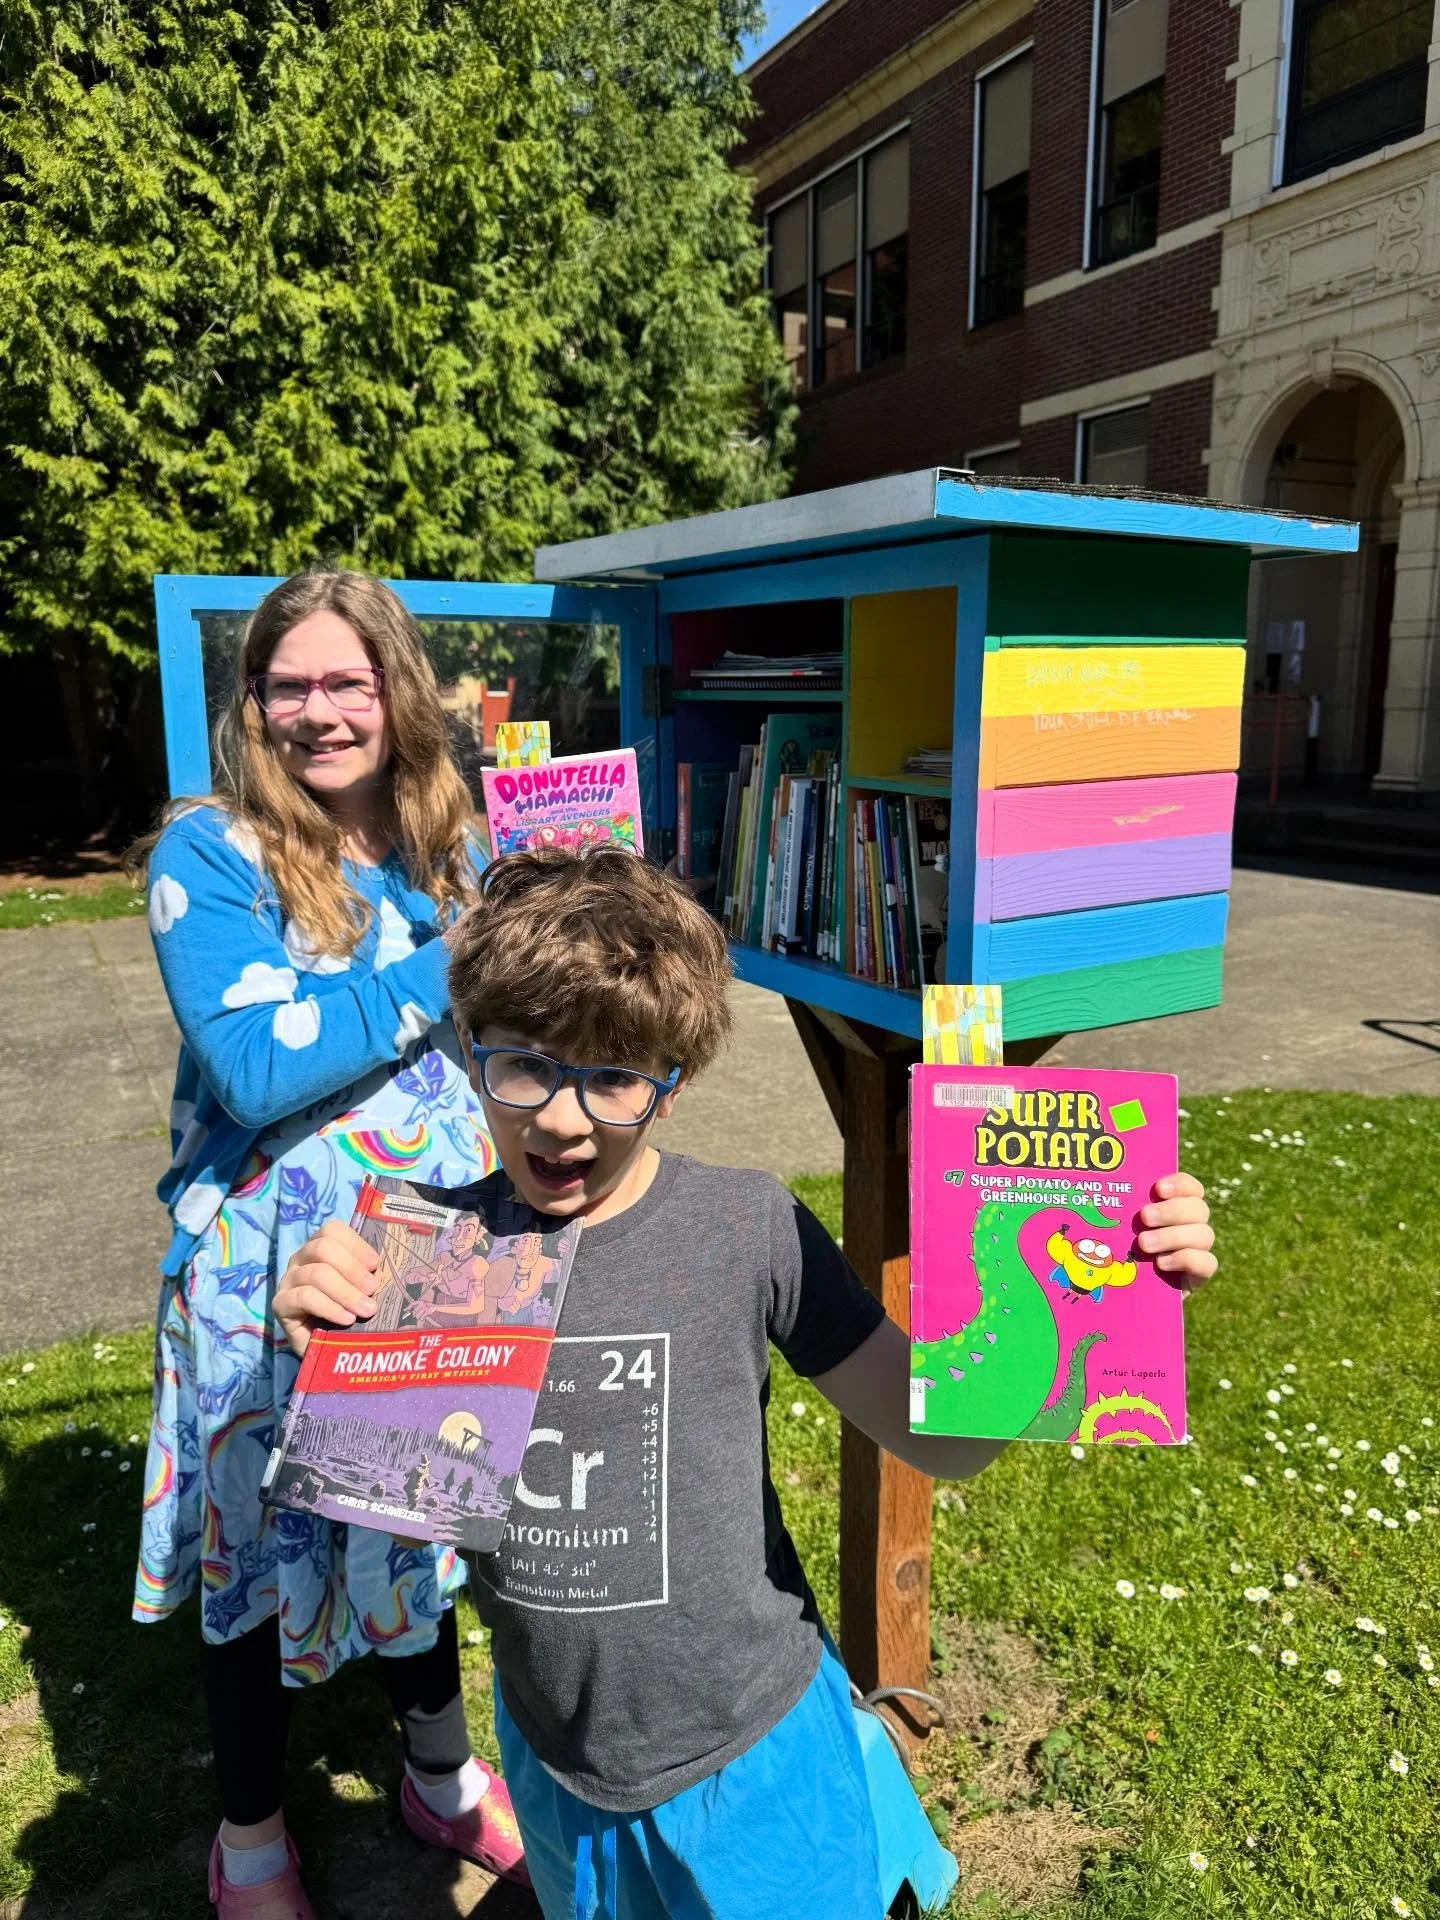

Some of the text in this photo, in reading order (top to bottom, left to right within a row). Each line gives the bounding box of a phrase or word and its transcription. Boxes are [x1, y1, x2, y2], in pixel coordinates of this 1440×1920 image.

[495, 764, 626, 804] DONUTELLA
[514, 787, 614, 815] HAMACHI
[516, 808, 611, 827] LIBRARY AVENGERS
[976, 1127, 1123, 1170] POTATO
[944, 1171, 1132, 1193] #7 SUPER POTATO AND THE
[980, 1189, 1122, 1207] GREENHOUSE OF EVIL
[418, 1334, 442, 1347] THE
[333, 1345, 516, 1374] ROANOKE COLONY
[348, 1369, 491, 1384] AMERICA'S FIRST MYSTERY
[598, 1349, 657, 1391] 24
[1102, 1368, 1166, 1379] Artur Laperla
[548, 1380, 576, 1393] 1.66
[642, 1403, 659, 1417] +6
[641, 1419, 658, 1433] +5
[641, 1435, 658, 1449] +4
[641, 1451, 657, 1465] +3
[514, 1428, 605, 1510] Cr
[336, 1494, 369, 1511] CHRIS
[644, 1515, 657, 1528] -2
[503, 1522, 629, 1548] hromium
[505, 1575, 609, 1600] Transition Metal
